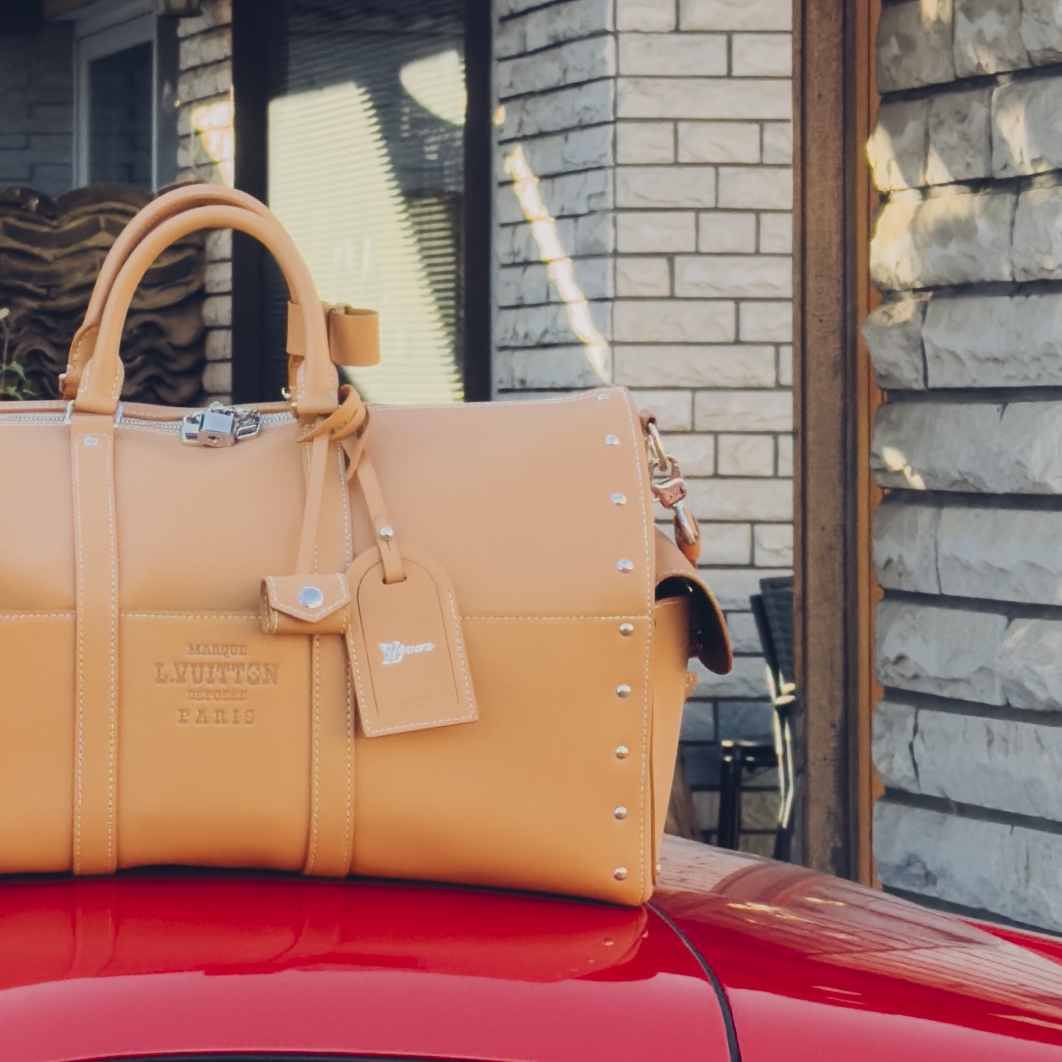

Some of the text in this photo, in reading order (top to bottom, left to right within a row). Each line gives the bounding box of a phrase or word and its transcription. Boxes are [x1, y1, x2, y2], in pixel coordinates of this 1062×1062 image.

[187, 644, 247, 658] MARQUE
[154, 661, 280, 685] L.VUITTON
[178, 708, 256, 725] PARIS
